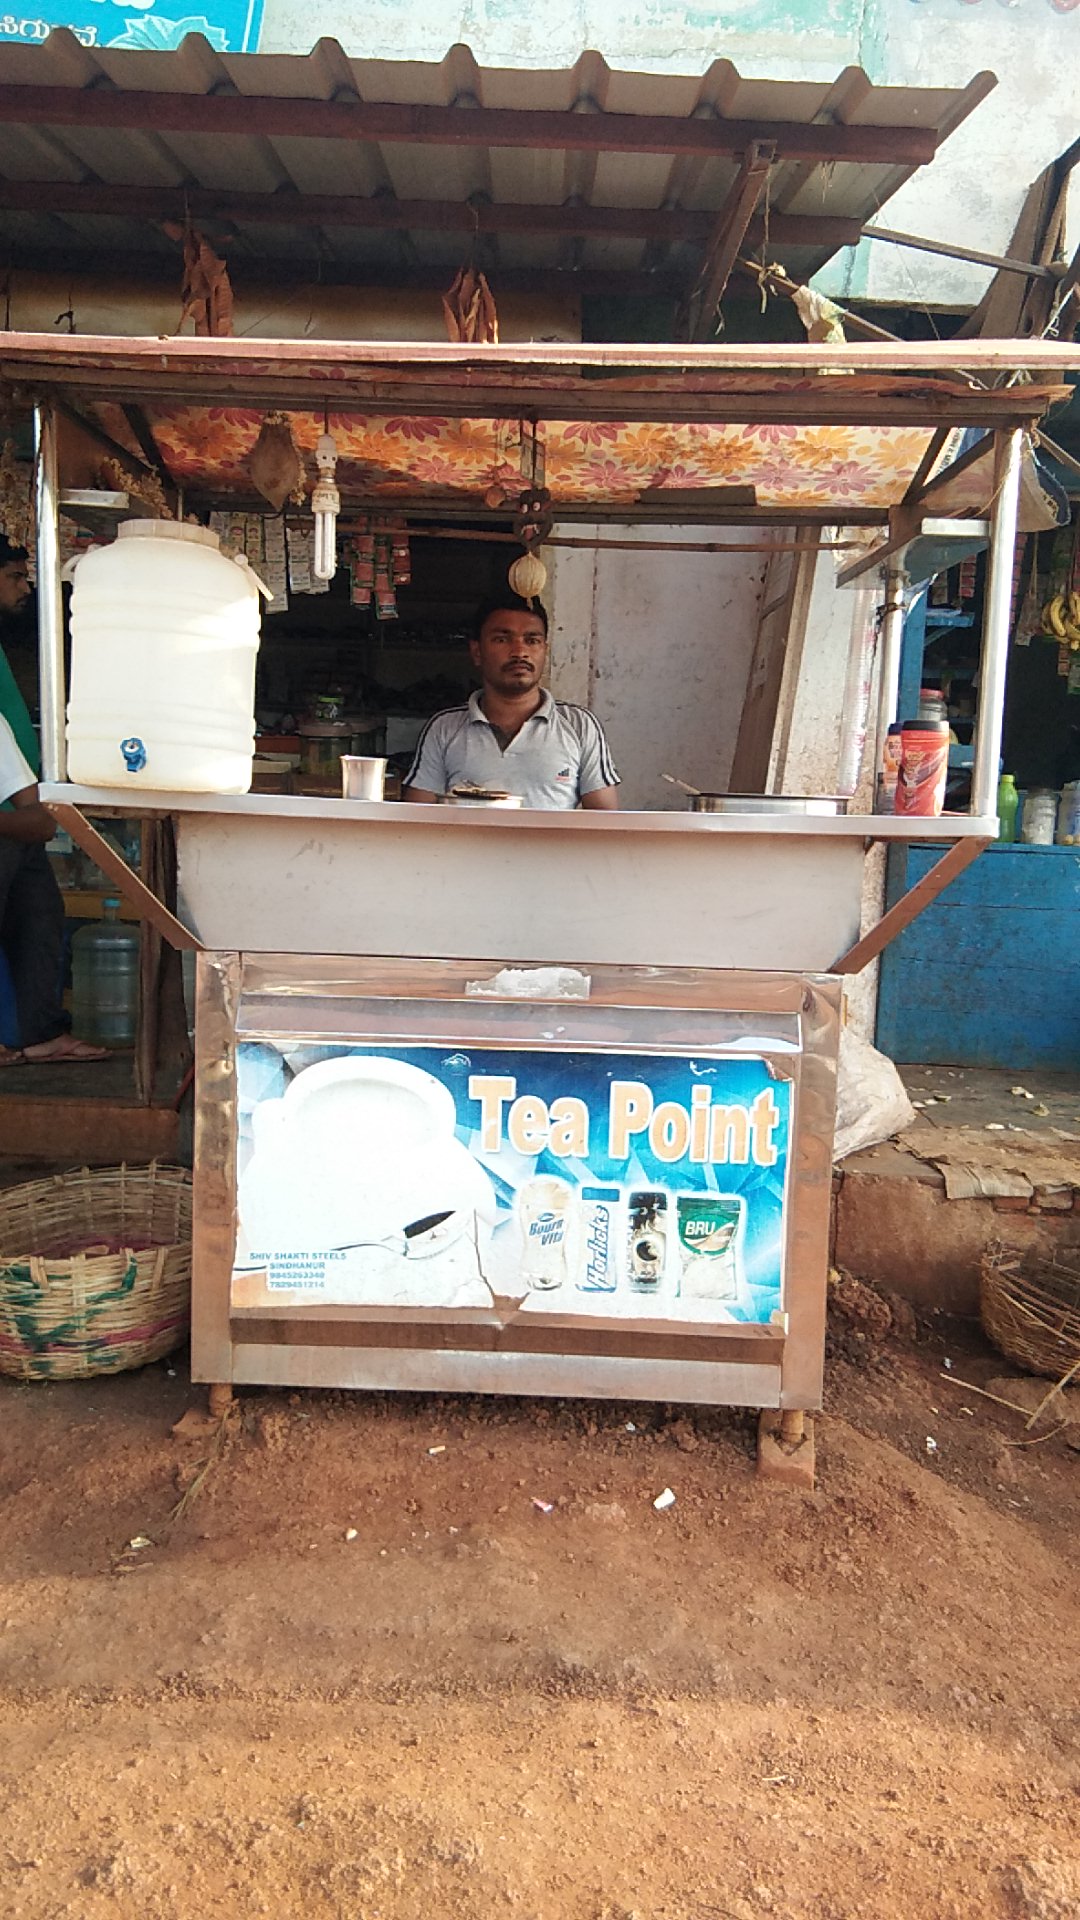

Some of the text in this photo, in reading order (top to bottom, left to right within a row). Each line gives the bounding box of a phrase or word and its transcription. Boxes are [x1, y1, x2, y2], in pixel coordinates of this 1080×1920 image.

[468, 1075, 780, 1166] Tea Point
[685, 1220, 716, 1236] BRU
[586, 1204, 610, 1289] Horlicks
[249, 1252, 347, 1260] SHIV SHAKTI STEELS
[269, 1261, 326, 1270] SINDHANUR
